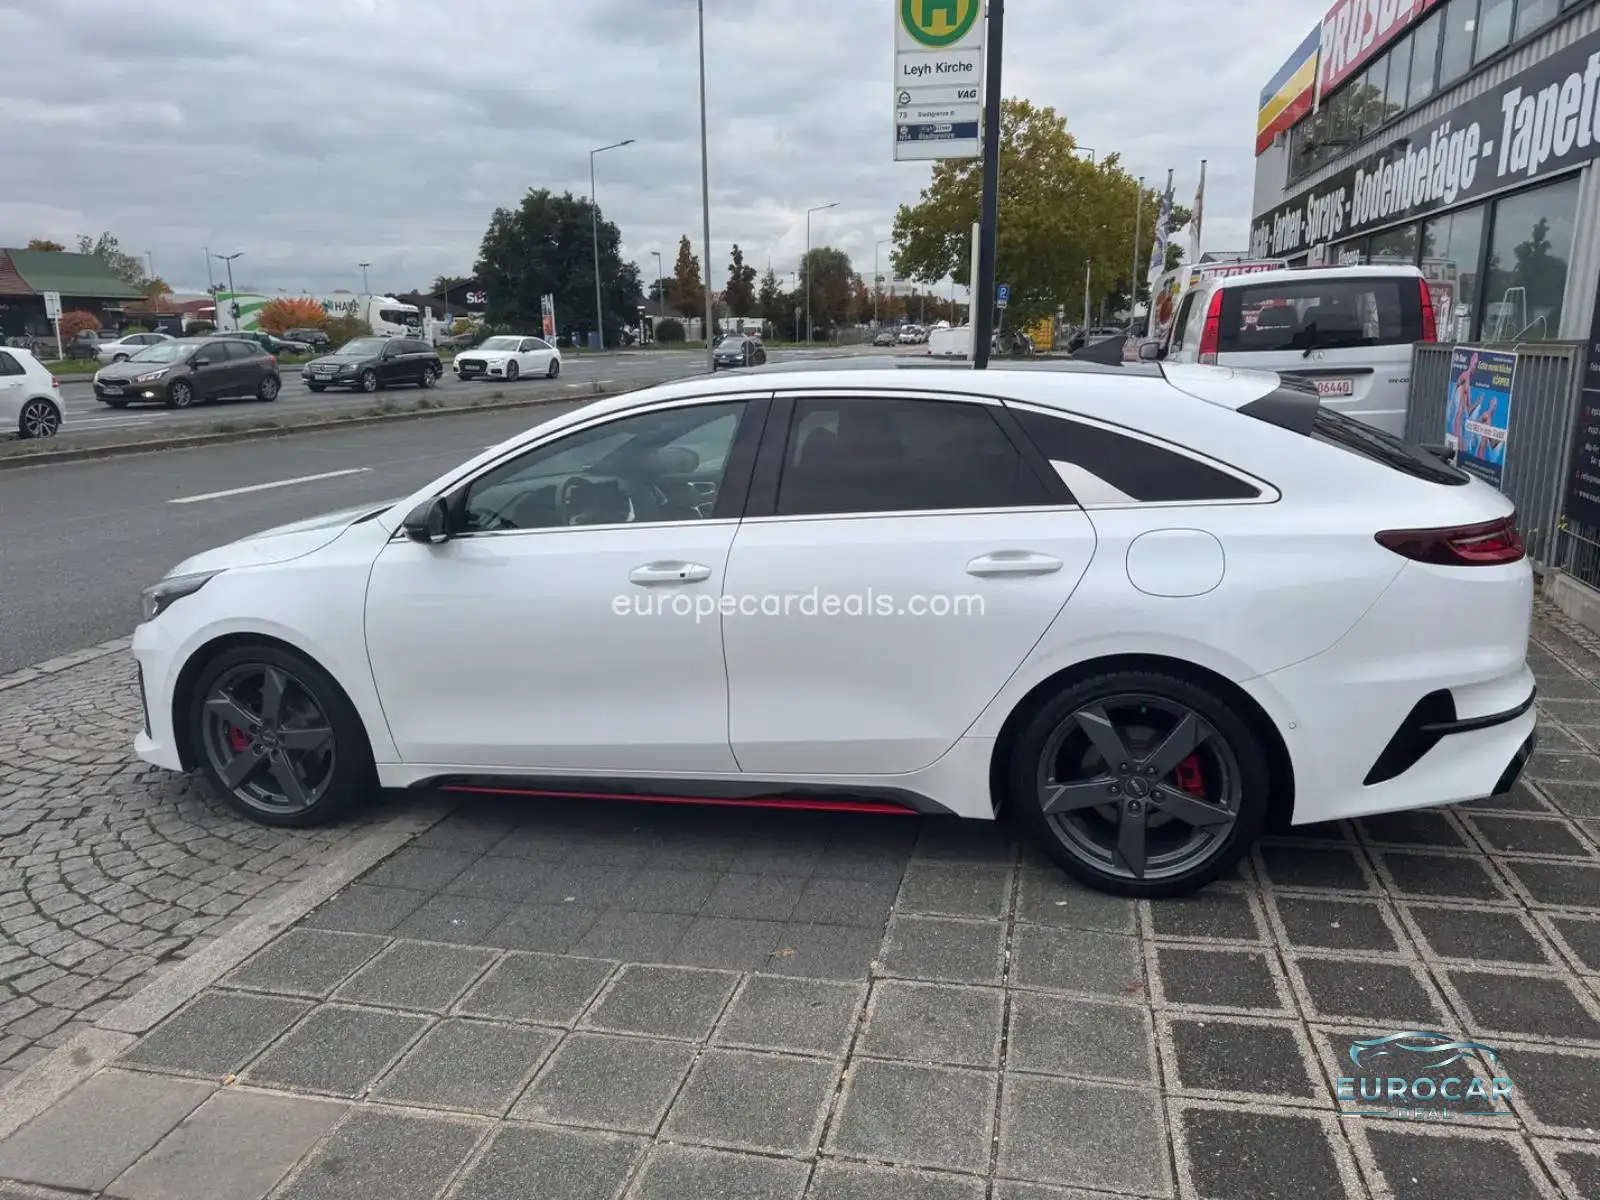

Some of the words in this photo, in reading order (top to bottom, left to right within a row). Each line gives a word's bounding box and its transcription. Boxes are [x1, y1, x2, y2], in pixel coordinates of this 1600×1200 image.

[1314, 0, 1415, 105] PROS
[904, 63, 932, 77] Leyh
[935, 61, 973, 74] Kirche
[957, 90, 977, 98] VAG
[1272, 207, 1302, 255] Farben
[1305, 187, 1345, 246] Sprays
[1351, 121, 1481, 227] Bodenbeläge
[1317, 381, 1349, 393] 06440
